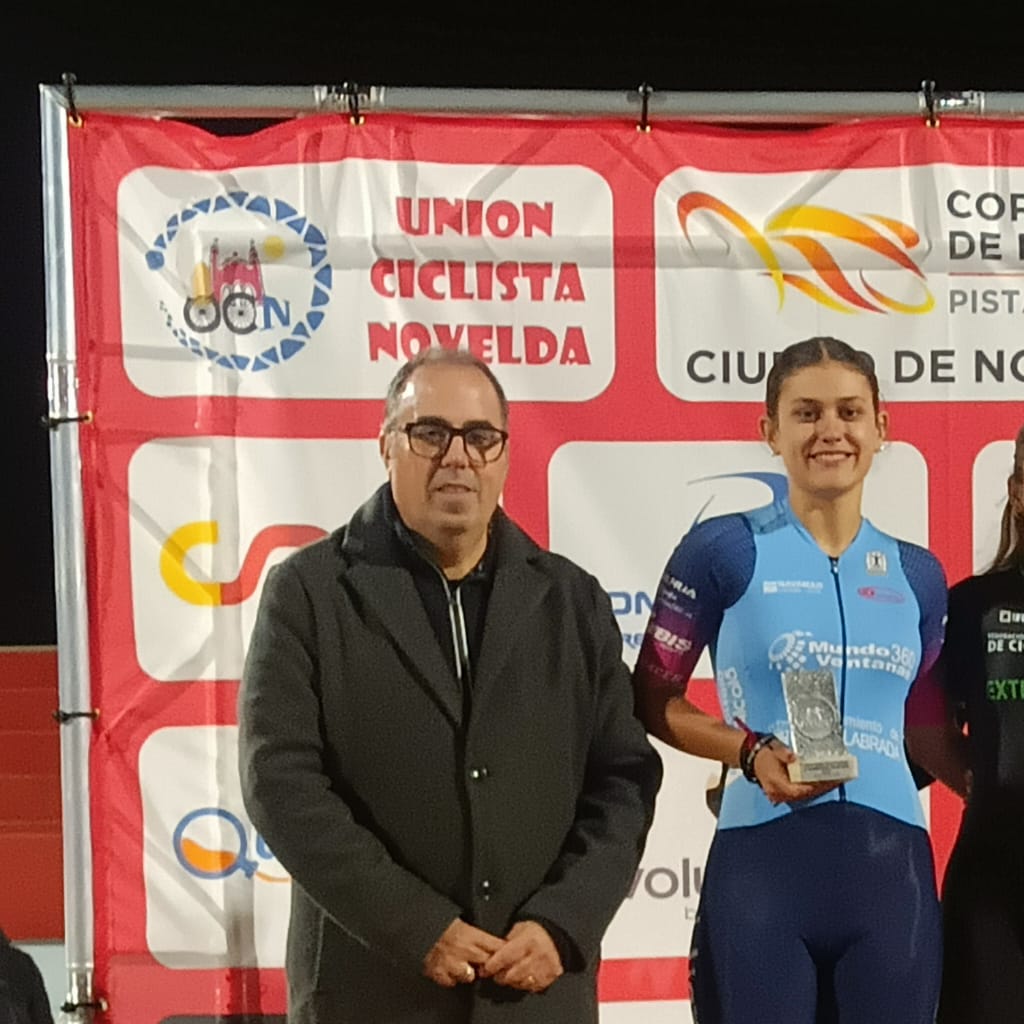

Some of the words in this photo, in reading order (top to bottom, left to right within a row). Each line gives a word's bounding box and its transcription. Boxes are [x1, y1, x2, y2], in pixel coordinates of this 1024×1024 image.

[395, 196, 554, 238] UNION
[948, 232, 1003, 261] DE
[370, 258, 586, 302] CICLISTA
[367, 320, 592, 366] NOVELDA
[894, 350, 957, 385] DE
[808, 641, 891, 657] Mundo
[987, 639, 1004, 653] DE
